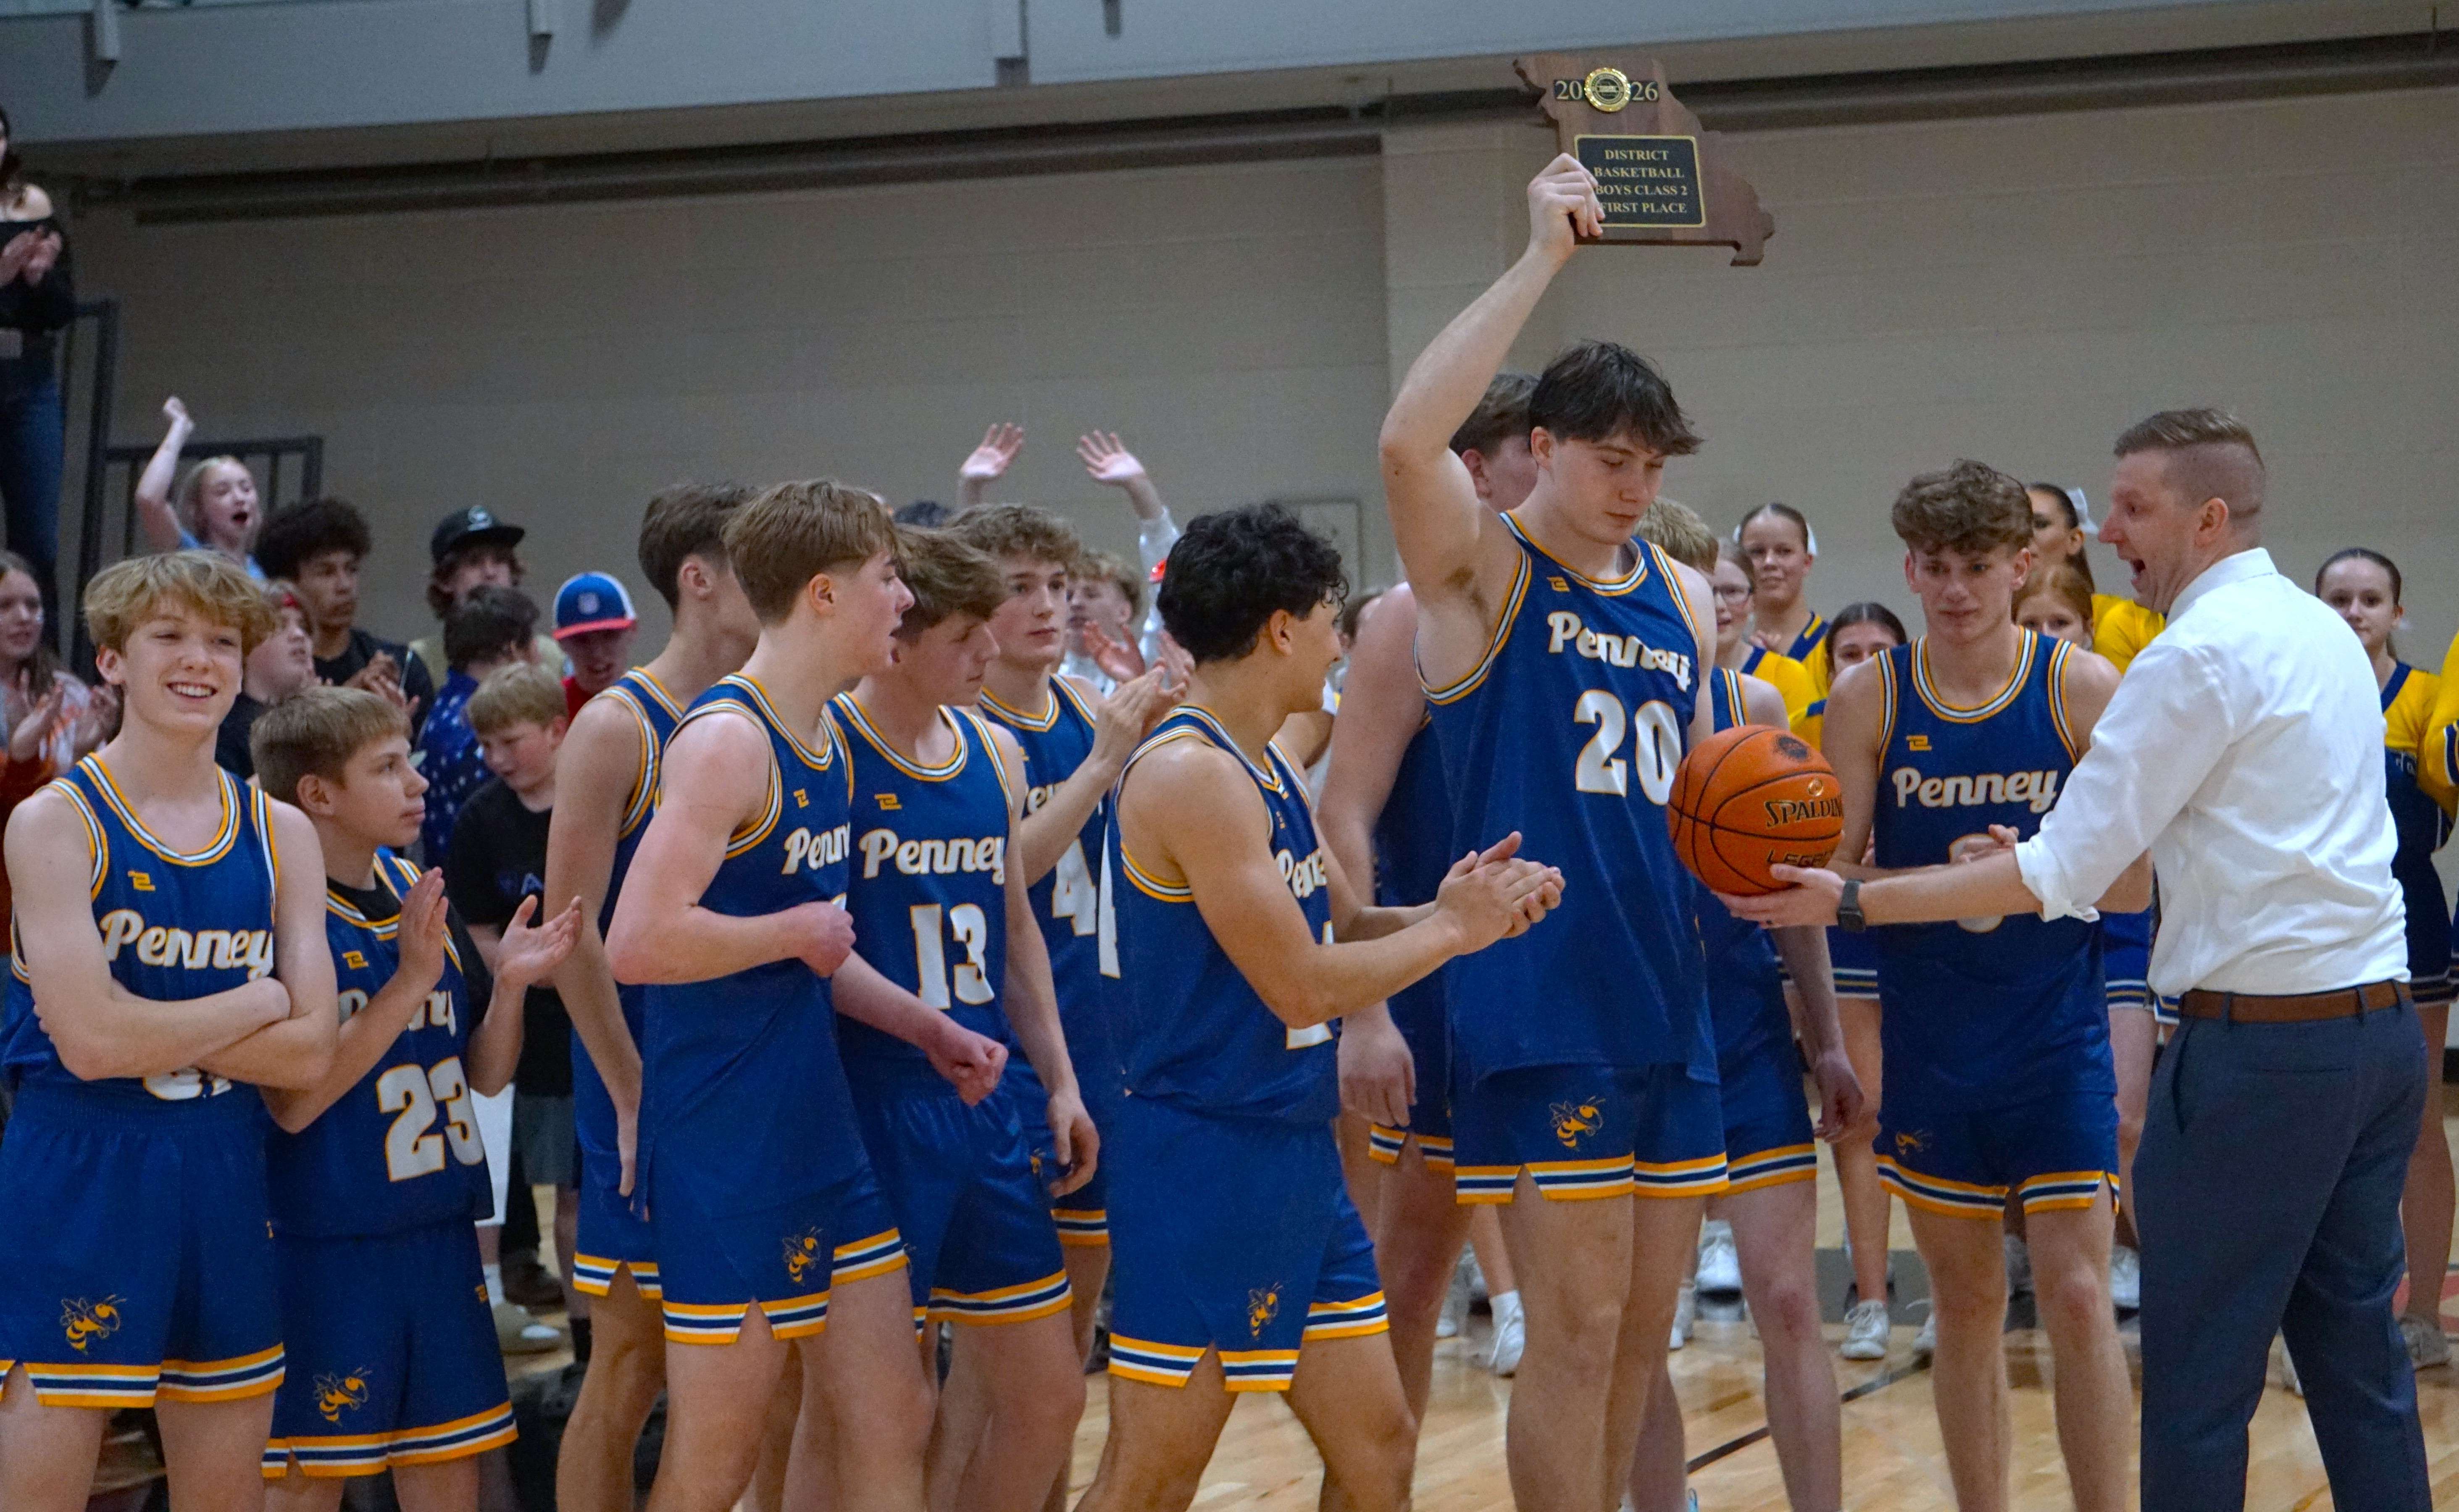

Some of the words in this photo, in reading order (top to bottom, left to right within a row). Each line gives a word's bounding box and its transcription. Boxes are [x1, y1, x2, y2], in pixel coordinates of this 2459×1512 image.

[1555, 80, 1583, 100] 20
[1631, 81, 1658, 101] 26
[1594, 167, 1684, 178] BASKETBALL
[1604, 150, 1669, 160] DISTRICT
[1596, 184, 1631, 195] BOYS
[1634, 184, 1678, 195] CLASS
[1681, 186, 1688, 196] 2
[1642, 202, 1687, 213] PLACE
[1547, 610, 1691, 692] Penney
[1574, 689, 1681, 806] 20
[1765, 795, 1844, 828] SPALDIN
[1892, 766, 2058, 814] Penney
[781, 821, 850, 875] Penn
[859, 828, 1005, 885] Penney
[100, 909, 274, 981] Penney
[910, 903, 995, 1010] 13
[376, 1055, 485, 1183] 23
